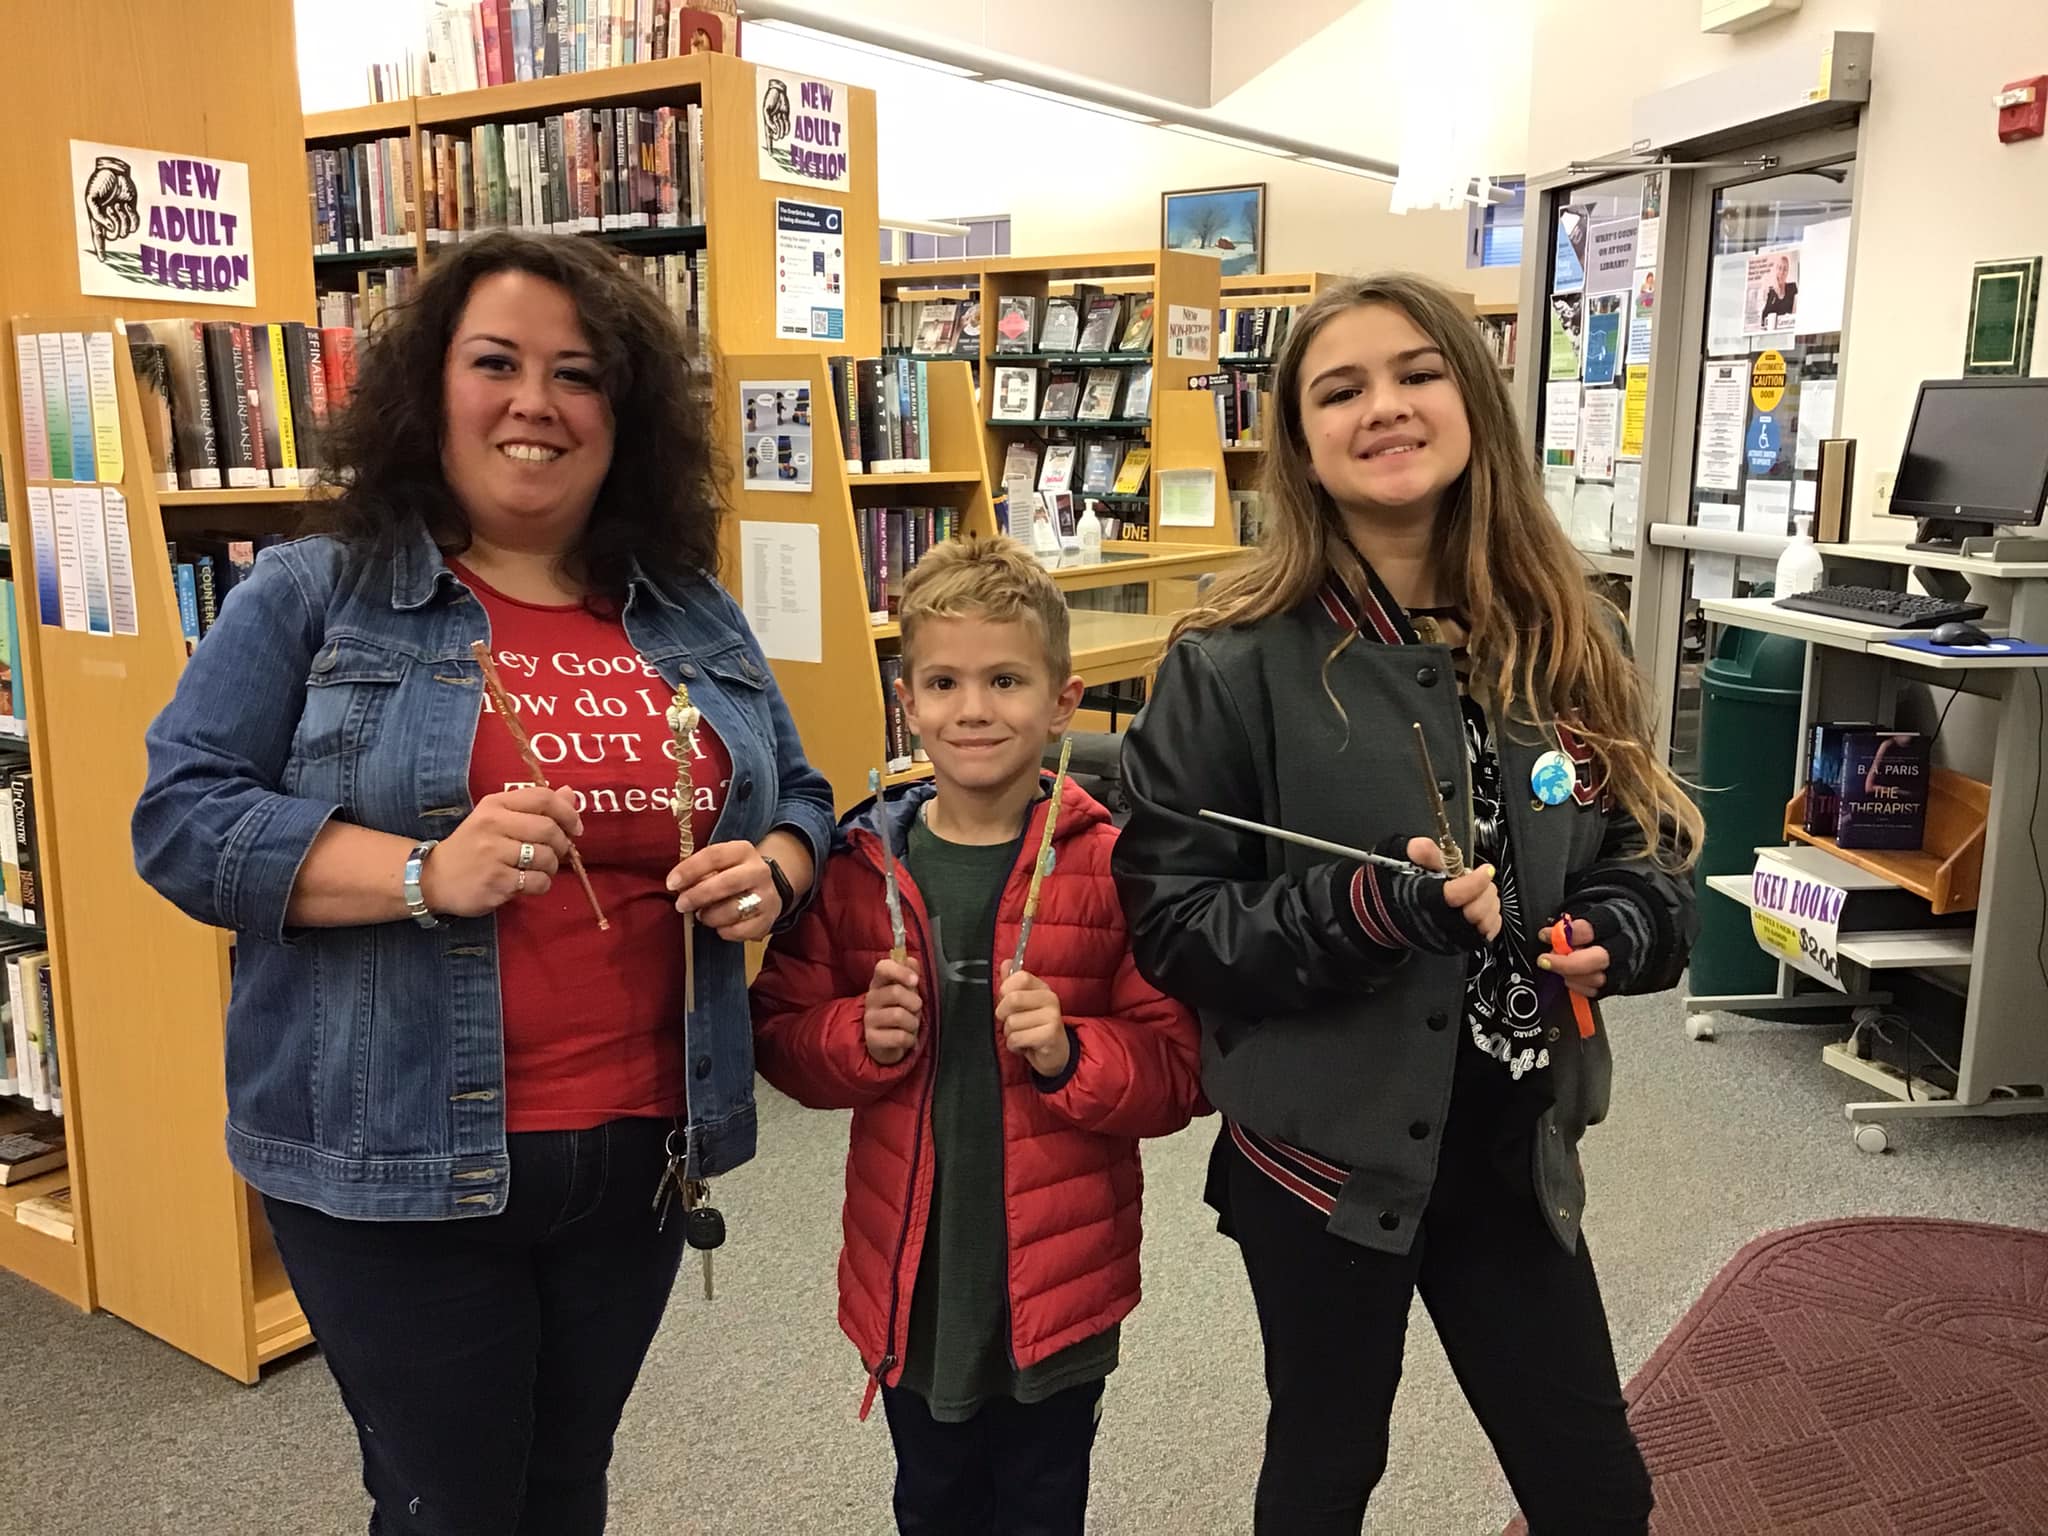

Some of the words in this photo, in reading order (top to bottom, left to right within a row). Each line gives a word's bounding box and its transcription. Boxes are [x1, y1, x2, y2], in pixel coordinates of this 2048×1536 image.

[801, 82, 833, 112] NEW
[795, 116, 841, 146] ADULT
[617, 137, 625, 165] MARTIN
[790, 144, 846, 181] FICTION
[158, 160, 220, 200] NEW
[149, 206, 237, 246] ADULT
[1595, 231, 1617, 243] WHAT'S
[1599, 247, 1607, 256] ON
[1608, 246, 1617, 255] AT
[1617, 243, 1631, 253] YOUR
[140, 244, 248, 292] FICTION
[1600, 259, 1628, 271] LIBRARY?
[245, 330, 253, 352] MARY
[232, 347, 245, 390] BLADE
[247, 355, 256, 387] BALOGH
[846, 362, 854, 378] FAYE
[1753, 375, 1784, 386] CAUTION
[191, 339, 208, 392] REALM
[200, 399, 217, 466] BREAKER
[848, 380, 856, 421] KELLERMAN
[875, 365, 886, 418] HEAT
[1760, 390, 1774, 398] DOOR
[237, 396, 253, 461] BREAKER
[879, 424, 886, 432] 2
[881, 530, 887, 538] of
[1122, 522, 1148, 540] ONE
[202, 566, 215, 630] COUNTERFE
[492, 650, 539, 677] ey
[552, 652, 661, 678] Goog
[574, 689, 628, 717] do
[635, 689, 662, 716] I
[530, 732, 641, 763] OUT
[662, 730, 707, 760] of
[1858, 765, 1867, 775] B.
[1872, 766, 1882, 775] A.
[1885, 765, 1919, 776] PARIS
[504, 779, 732, 813] onesa
[1874, 786, 1899, 799] THE
[1848, 802, 1920, 814] THERAPIST
[1754, 872, 1788, 911] USED
[1789, 880, 1845, 924] BOOKS
[1799, 928, 1840, 980] $2.00
